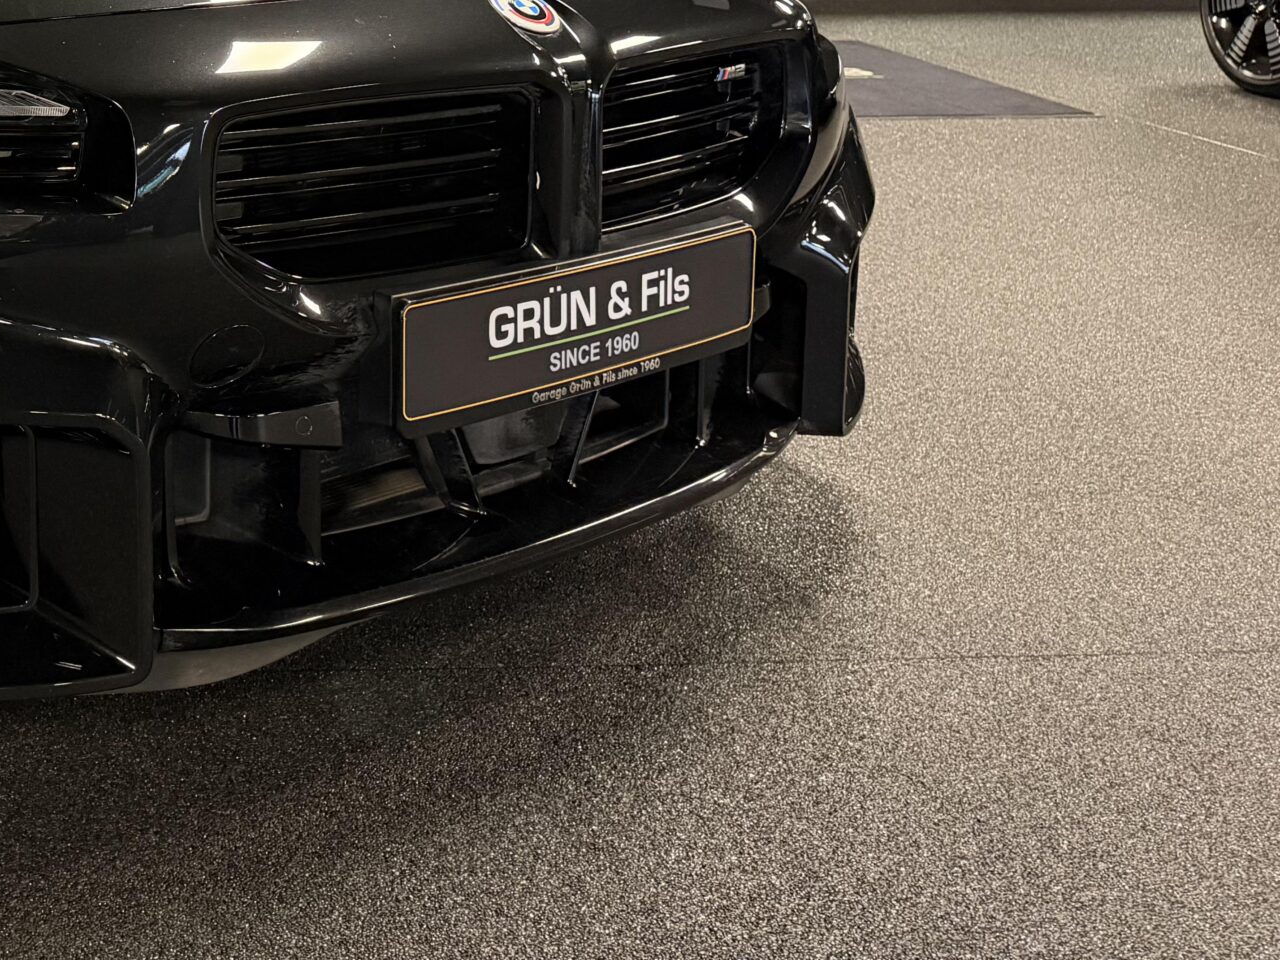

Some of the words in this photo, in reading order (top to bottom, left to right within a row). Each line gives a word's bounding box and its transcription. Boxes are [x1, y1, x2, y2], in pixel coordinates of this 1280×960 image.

[488, 285, 596, 349] GRÜN
[607, 280, 632, 320] &
[641, 267, 690, 312] Fils
[549, 342, 601, 372] SINCE
[605, 331, 640, 357] 1960
[532, 386, 567, 403] Garage
[569, 378, 592, 394] Grün
[593, 375, 601, 387] &
[602, 370, 616, 385] Fils
[617, 365, 638, 380] since
[640, 357, 660, 373] 1960
